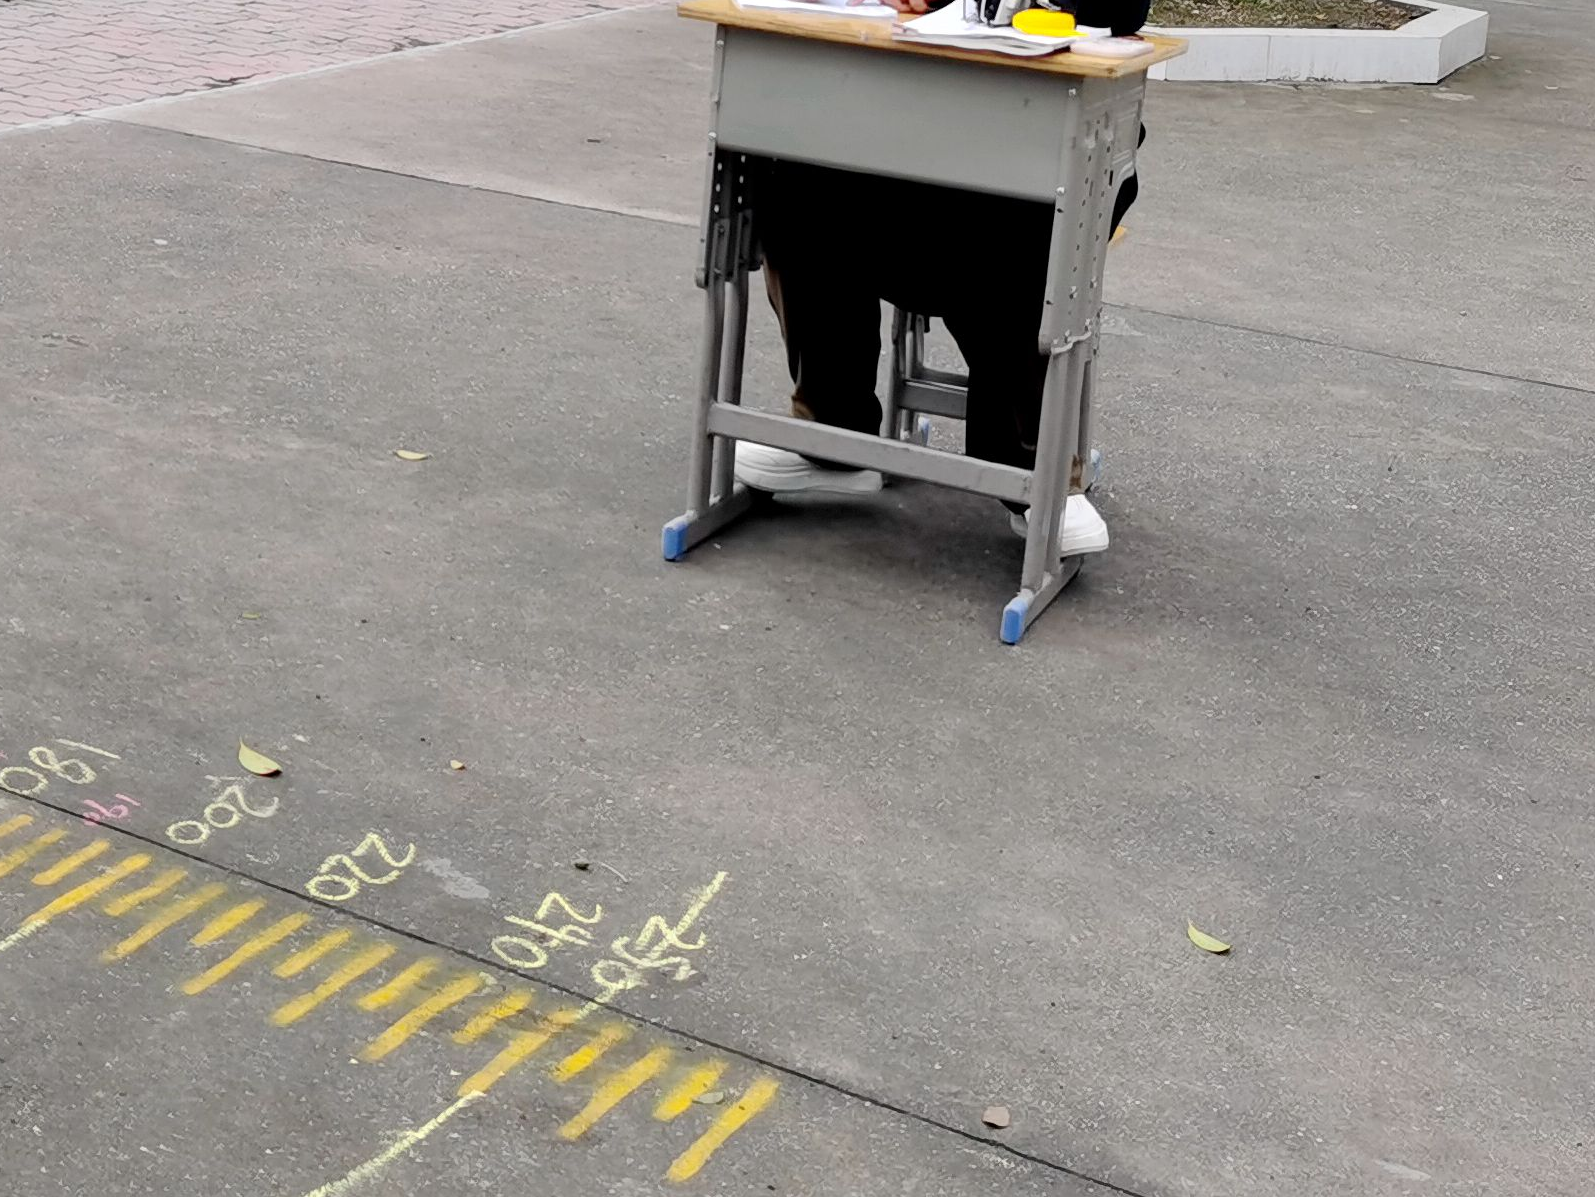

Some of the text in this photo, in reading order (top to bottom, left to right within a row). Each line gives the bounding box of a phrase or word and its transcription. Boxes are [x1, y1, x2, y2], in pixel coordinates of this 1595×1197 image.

[165, 781, 279, 845] 200
[305, 832, 417, 902] 220
[490, 891, 604, 970] 240
